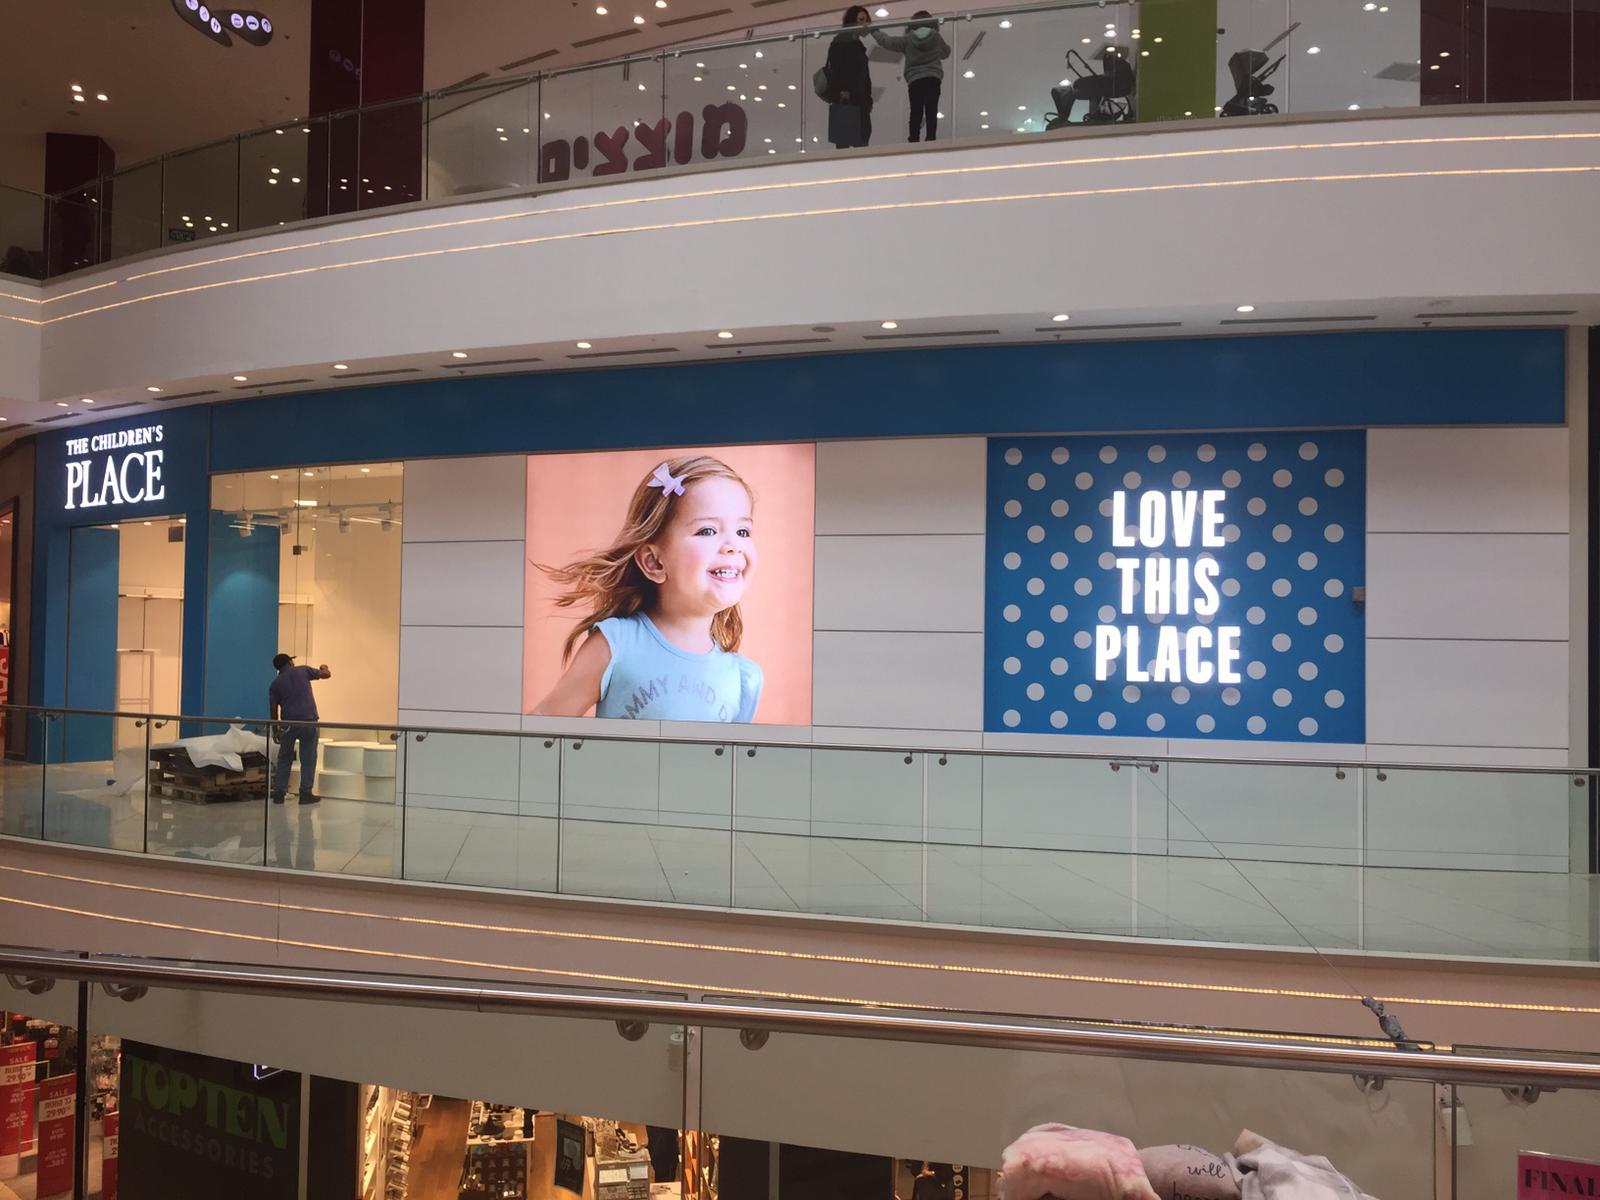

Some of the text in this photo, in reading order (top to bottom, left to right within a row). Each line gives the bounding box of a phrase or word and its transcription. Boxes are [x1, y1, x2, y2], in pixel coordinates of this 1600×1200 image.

[541, 102, 748, 183] מוצצים
[66, 425, 163, 455] THE CHILDREN'S
[64, 450, 165, 509] PLACE
[1112, 490, 1226, 548] LOVE
[1116, 557, 1220, 615] THIS
[1095, 625, 1241, 684] PLACE
[133, 1112, 275, 1179] ACCESSORIES
[1187, 1162, 1226, 1179] will
